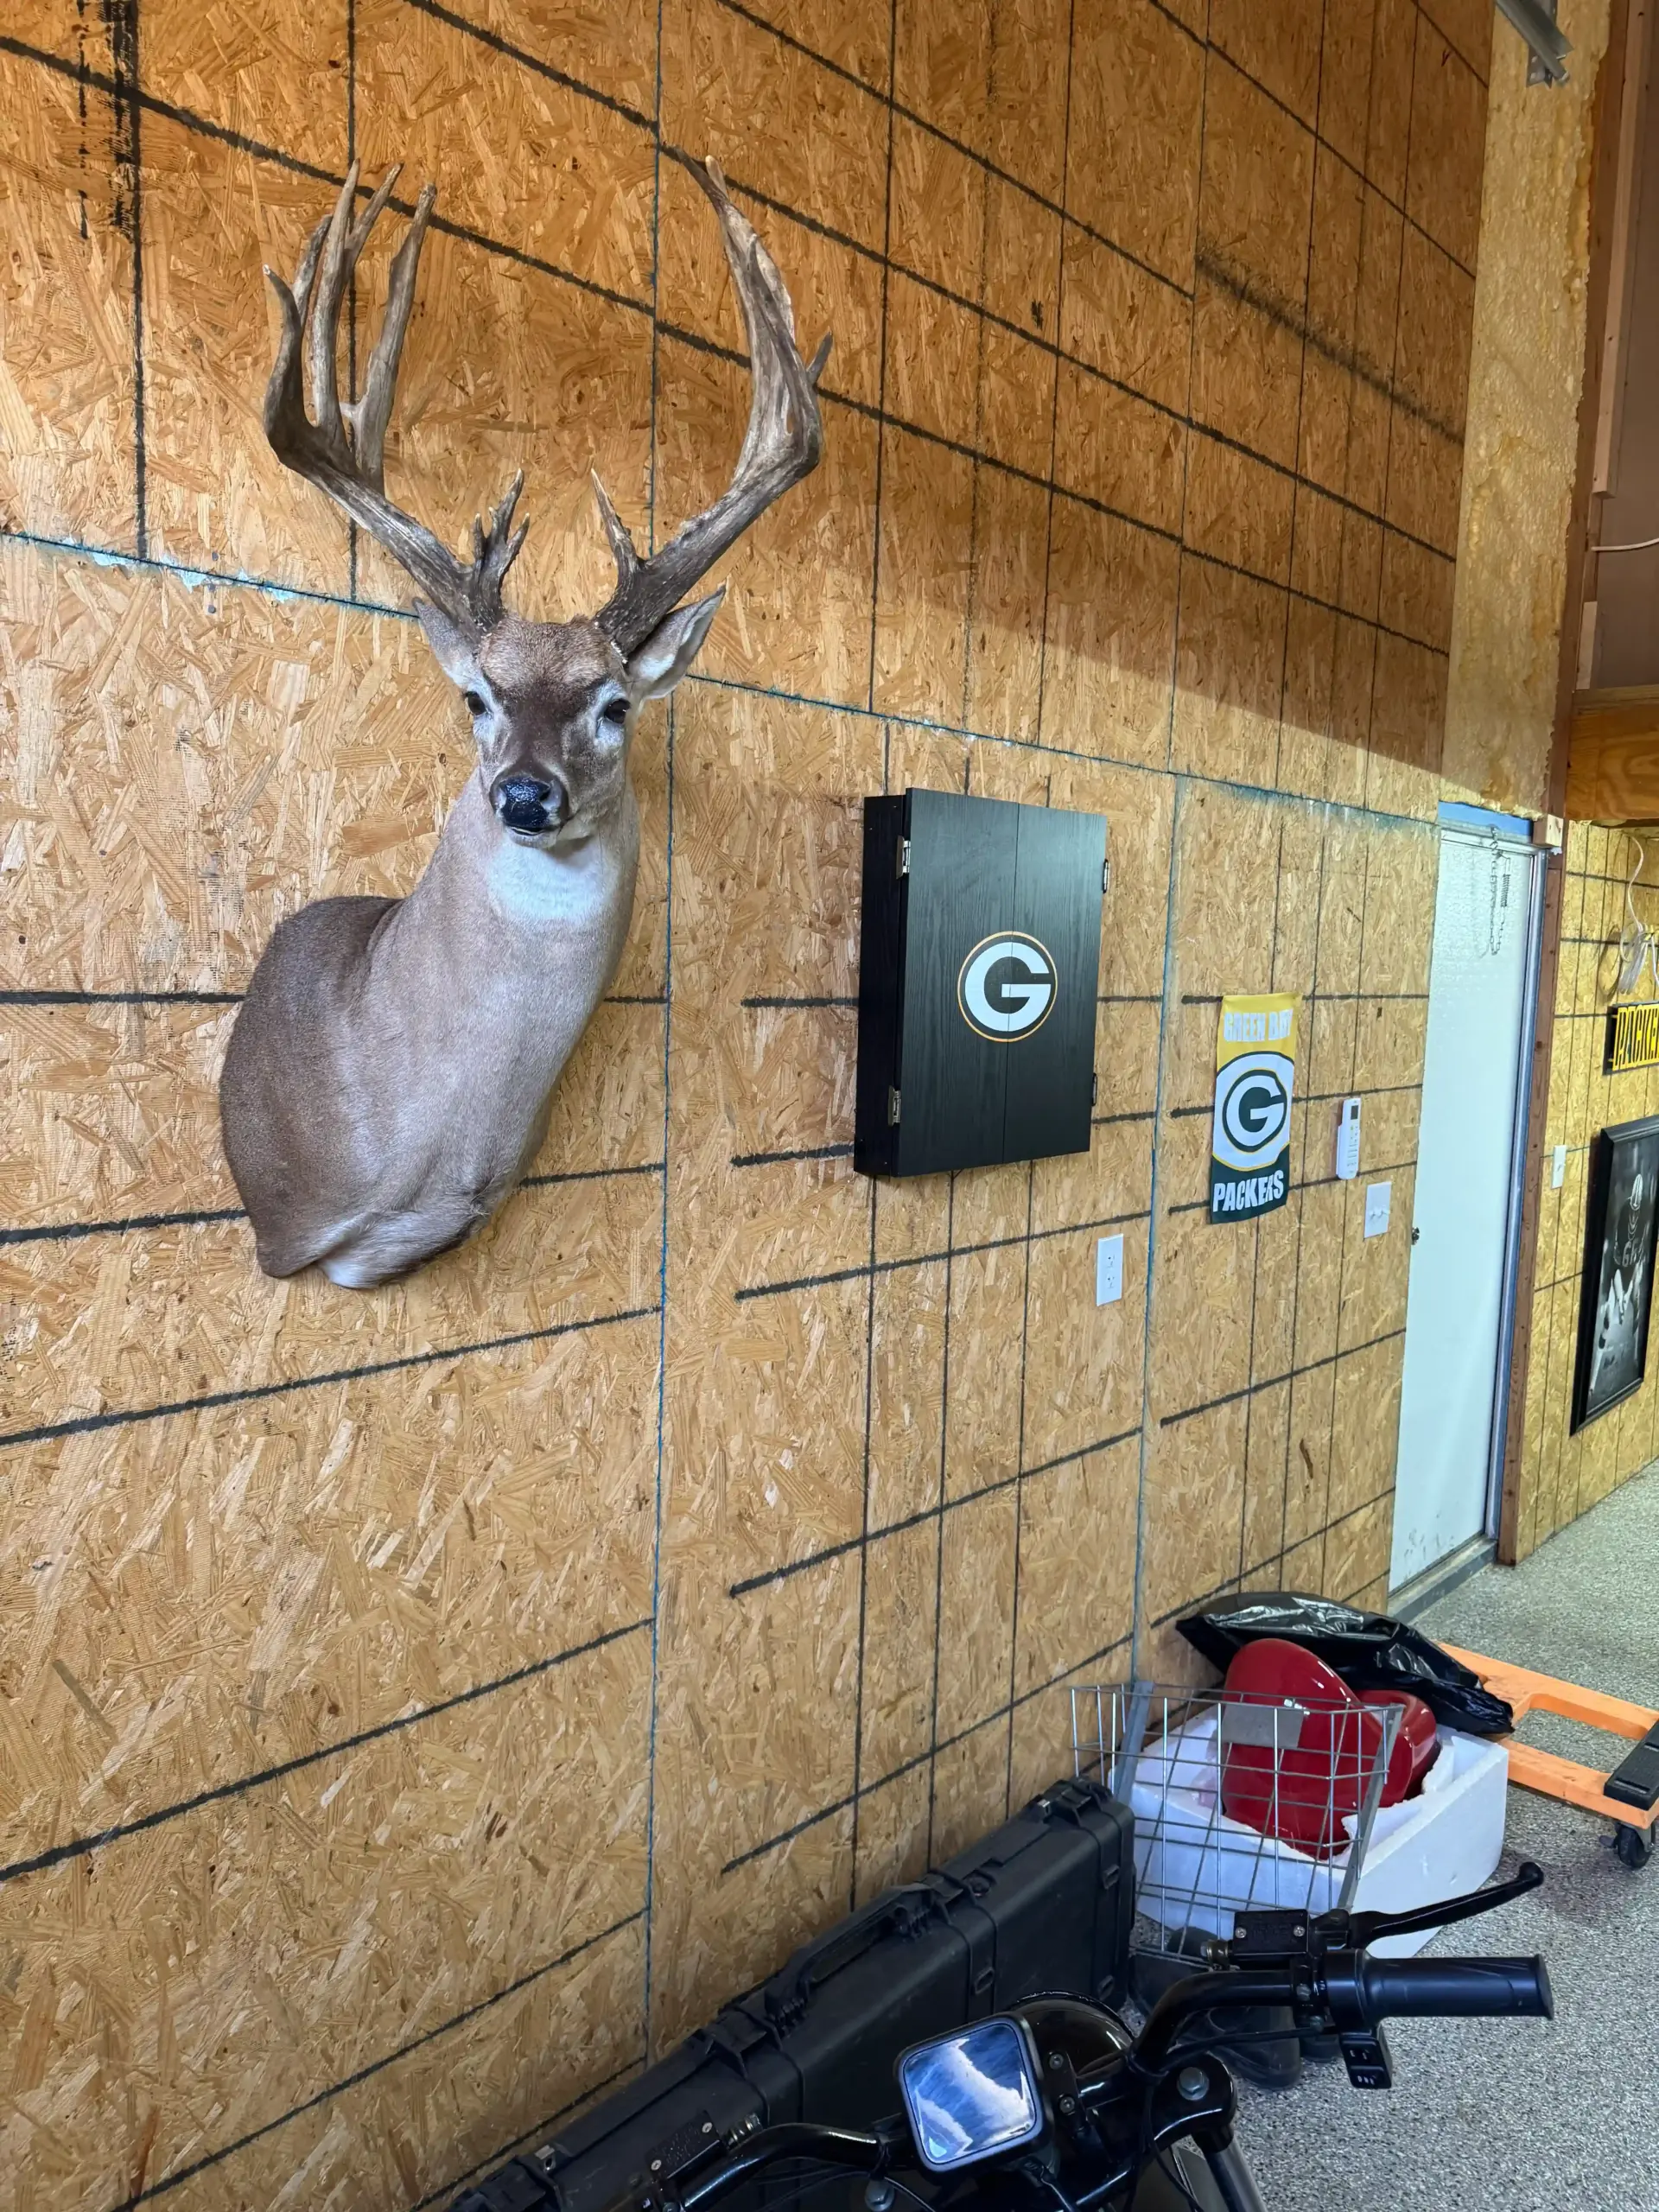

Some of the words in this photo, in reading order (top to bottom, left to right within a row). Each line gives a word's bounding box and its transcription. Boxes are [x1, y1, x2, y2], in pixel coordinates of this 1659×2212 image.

[964, 942, 1052, 1032] G
[1224, 1012, 1265, 1041] GREEN
[1268, 1008, 1293, 1040] BAY
[1612, 1004, 1659, 1071] PACKE
[1225, 1075, 1284, 1147] G
[1212, 1169, 1284, 1212] PACKERS
